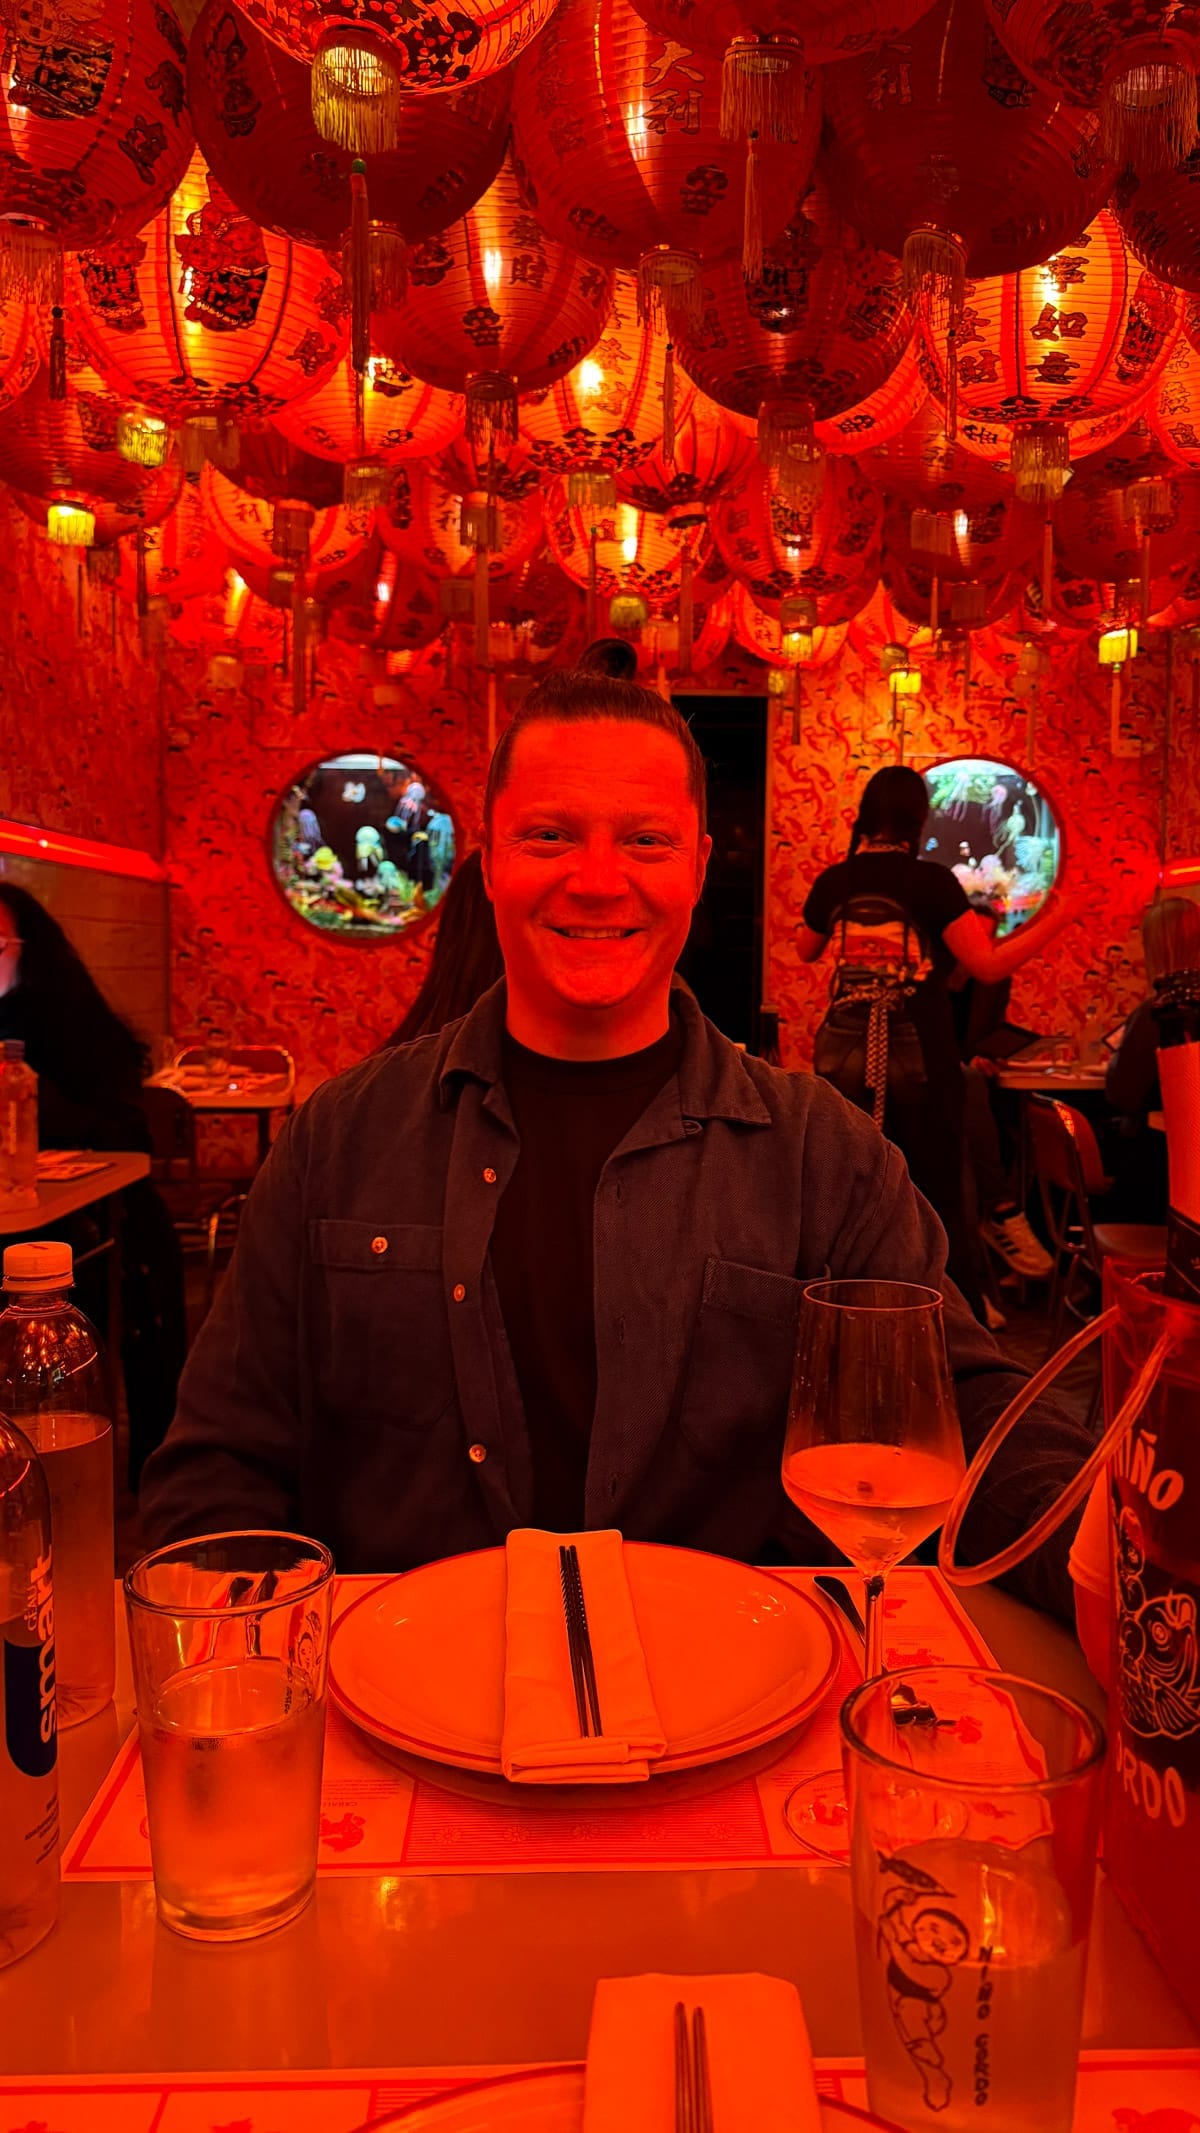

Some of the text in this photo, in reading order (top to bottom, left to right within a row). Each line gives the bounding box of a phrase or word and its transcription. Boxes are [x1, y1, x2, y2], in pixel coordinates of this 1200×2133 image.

[641, 39, 707, 135] 大利
[1025, 233, 1092, 386] 事如意
[31, 1545, 56, 1743] smart
[974, 2033, 990, 2106] GORDO
